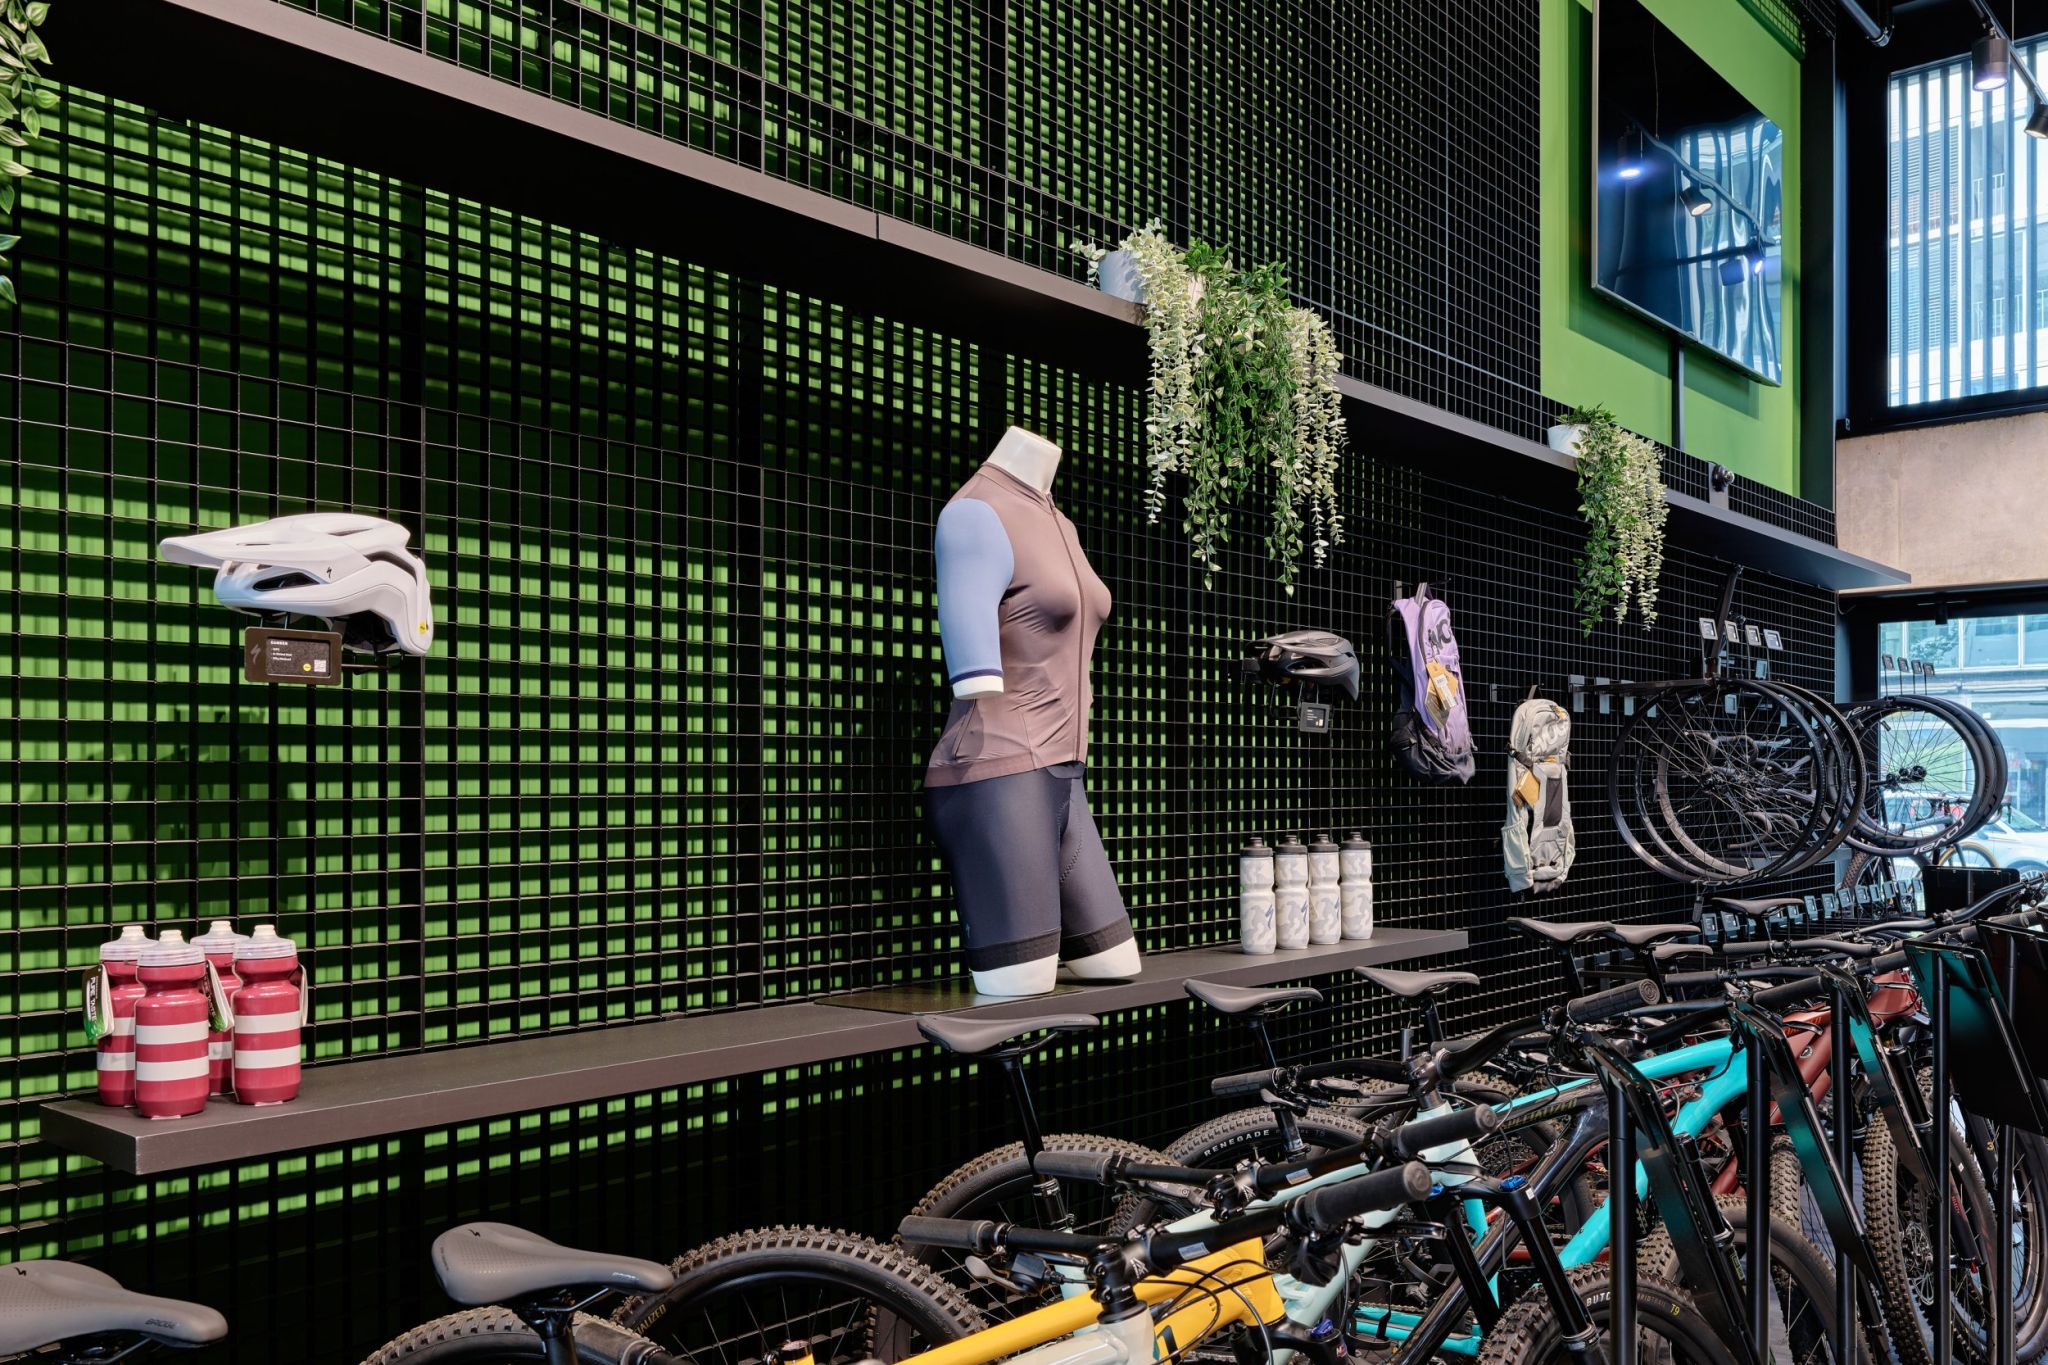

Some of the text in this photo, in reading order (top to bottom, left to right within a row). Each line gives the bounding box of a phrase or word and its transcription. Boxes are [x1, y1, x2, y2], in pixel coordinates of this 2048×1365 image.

[1203, 1129, 1270, 1157] RENEGADE
[1586, 1291, 1612, 1307] BUTC
[1670, 1303, 1681, 1316] T9
